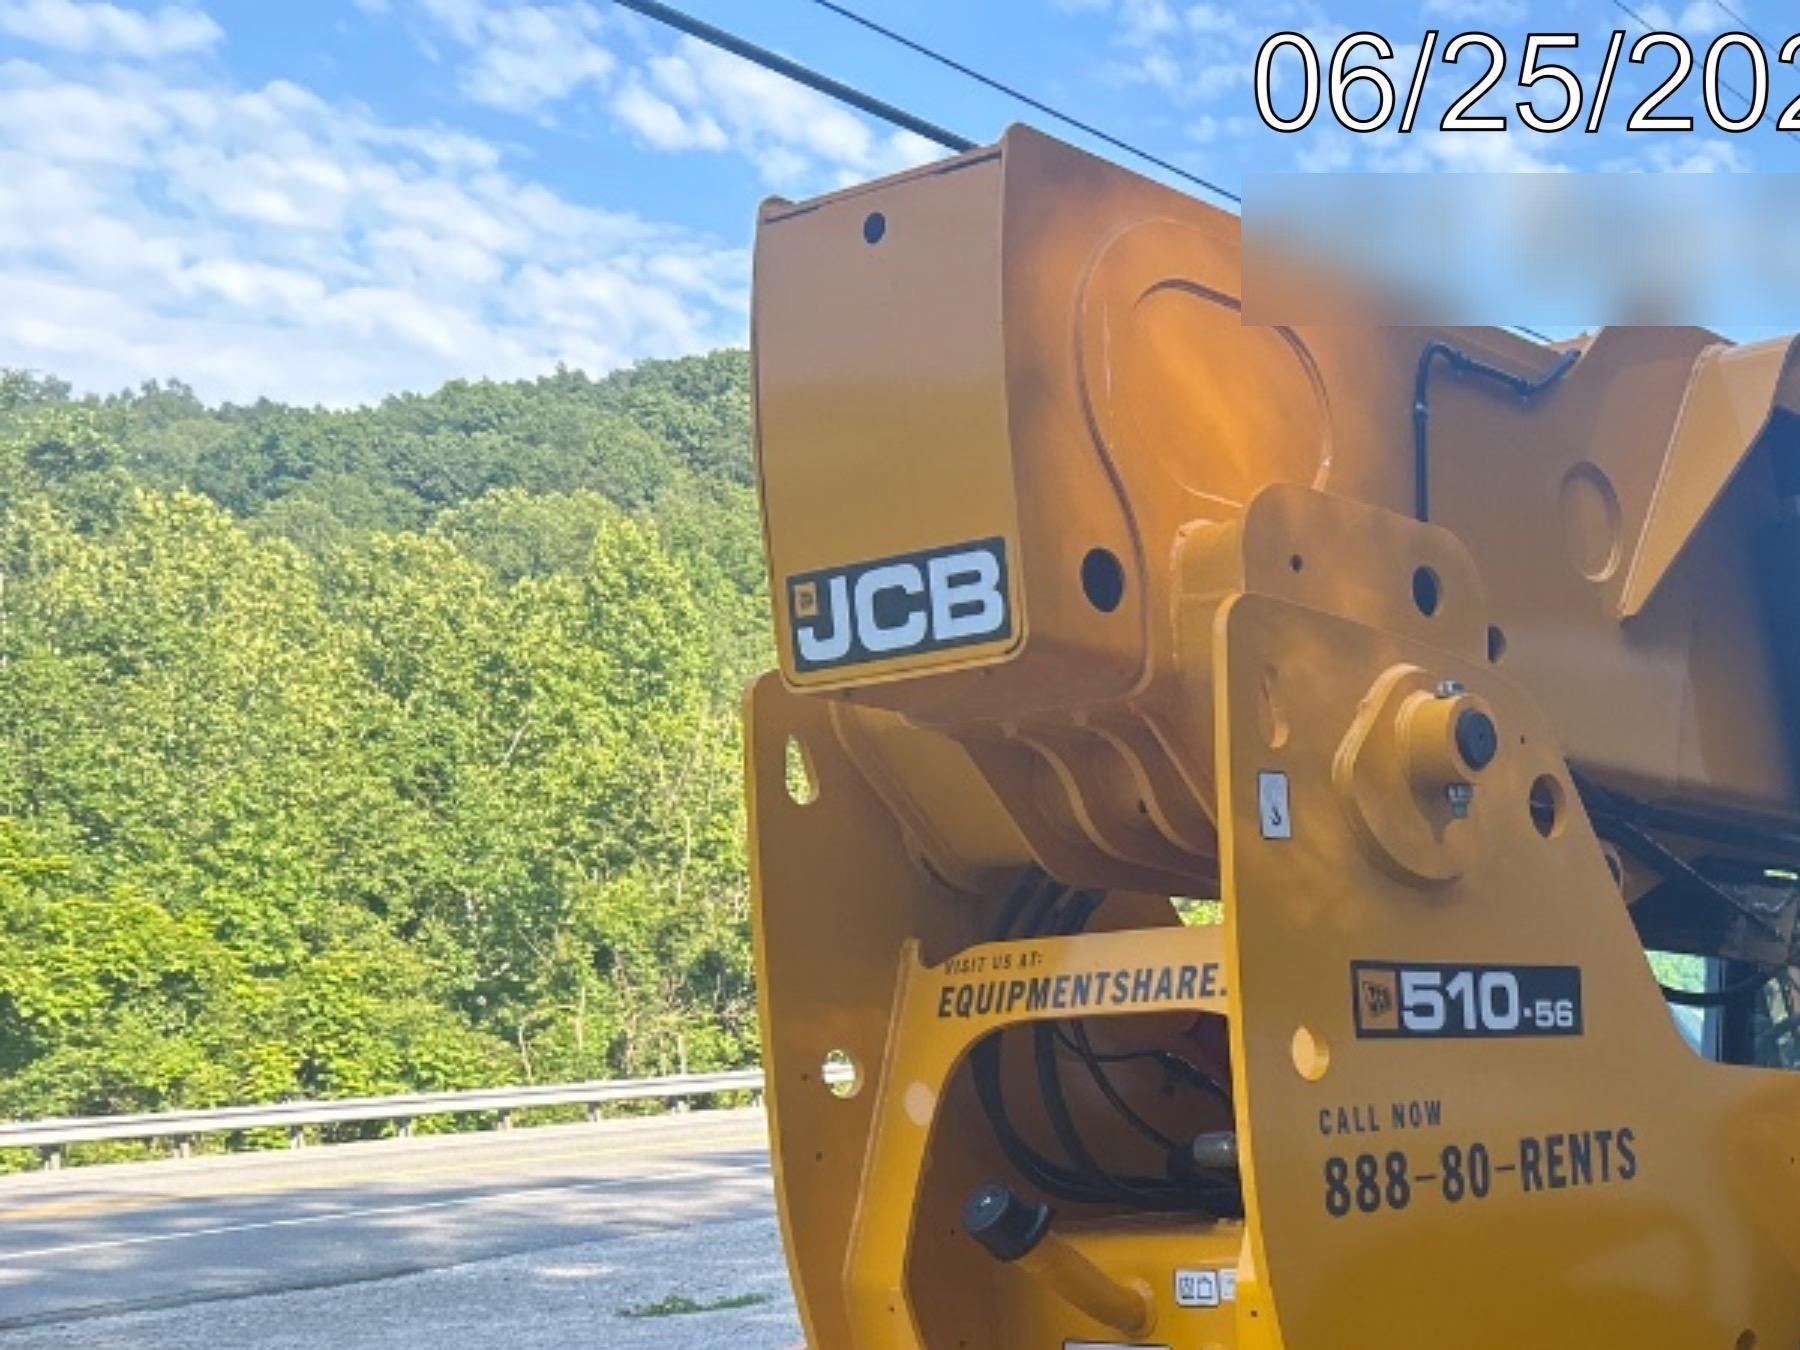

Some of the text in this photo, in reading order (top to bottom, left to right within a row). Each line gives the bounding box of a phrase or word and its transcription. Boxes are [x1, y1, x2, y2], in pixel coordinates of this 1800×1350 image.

[797, 549, 1004, 662] JCB
[944, 956, 987, 975] VISIT
[992, 953, 1012, 970] US
[1318, 1099, 1442, 1135] CALL NOW
[1324, 1127, 1638, 1218] 888-80-RENTS
